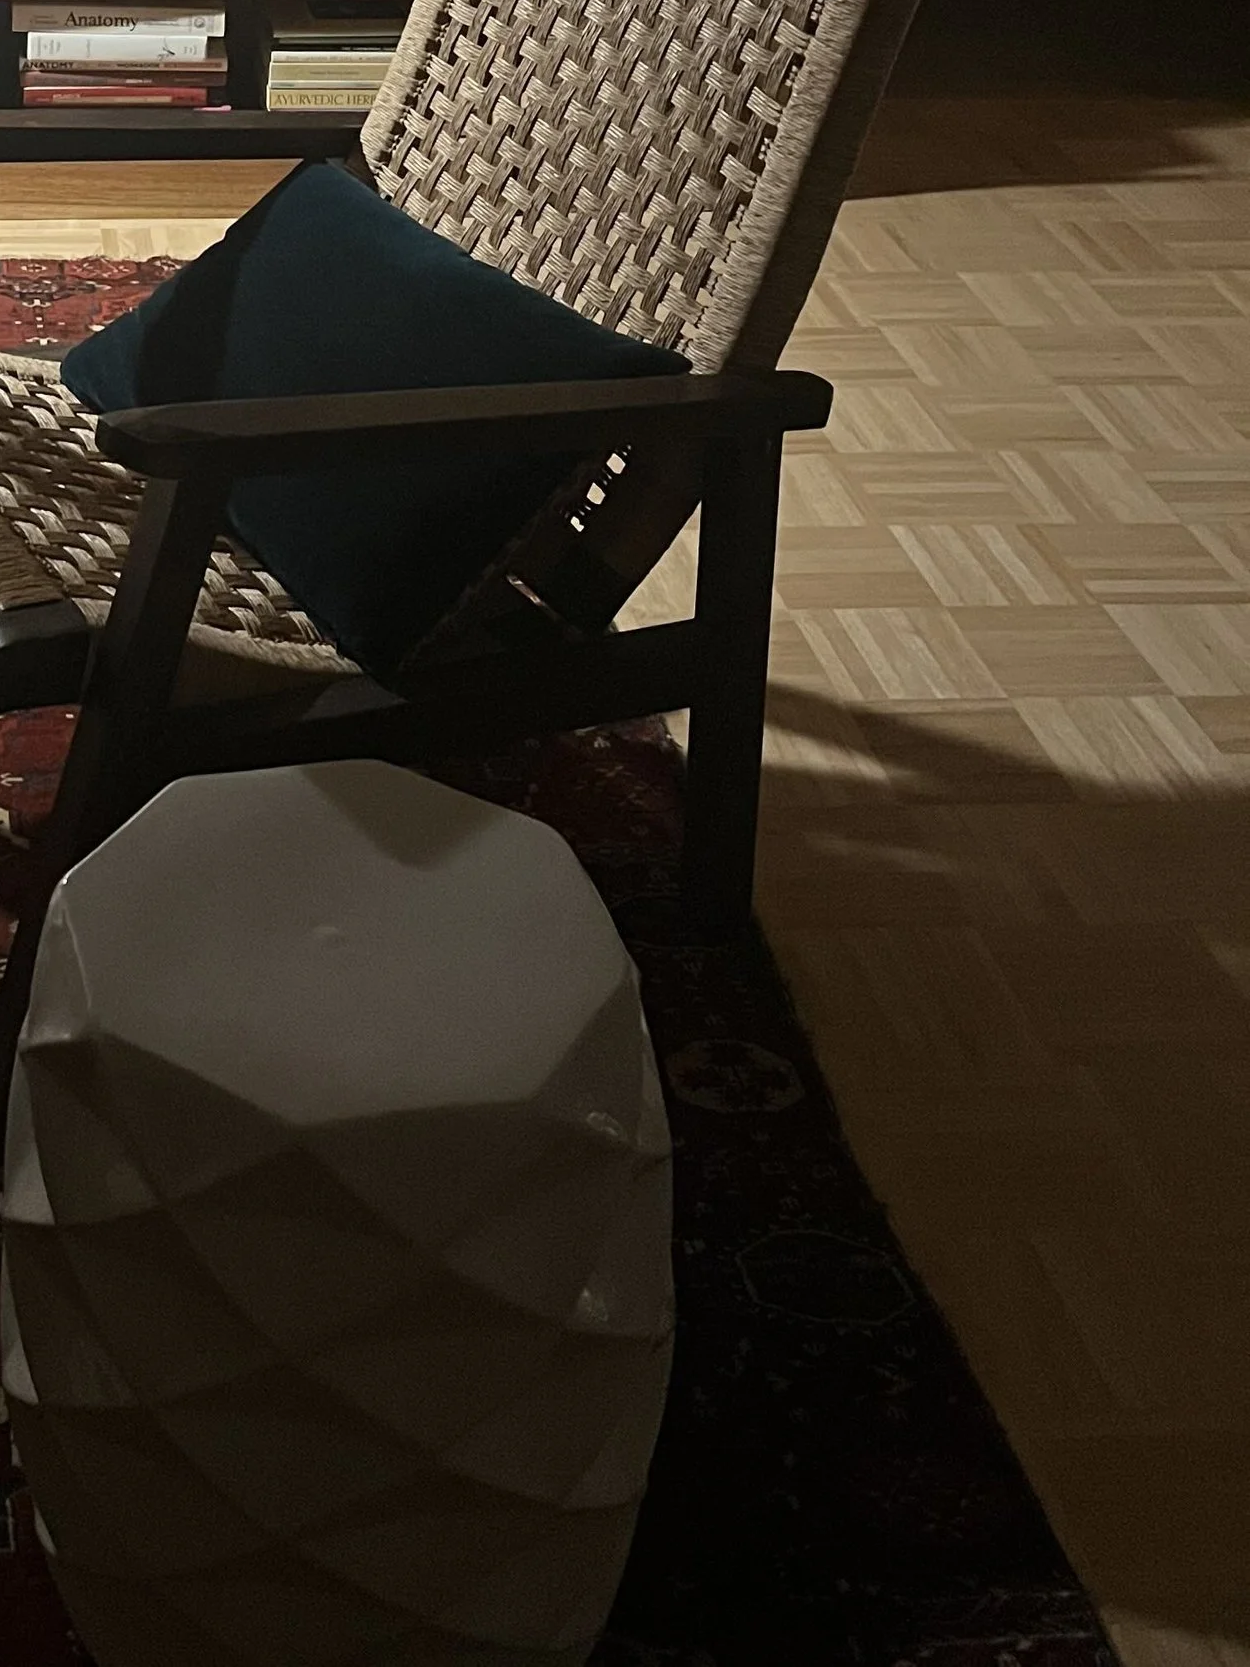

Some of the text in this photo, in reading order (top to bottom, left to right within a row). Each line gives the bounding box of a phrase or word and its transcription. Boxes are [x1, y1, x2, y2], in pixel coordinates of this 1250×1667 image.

[64, 12, 140, 31] Anatomy
[22, 60, 74, 70] ANATOMY
[275, 93, 339, 106] AYURVEDIC
